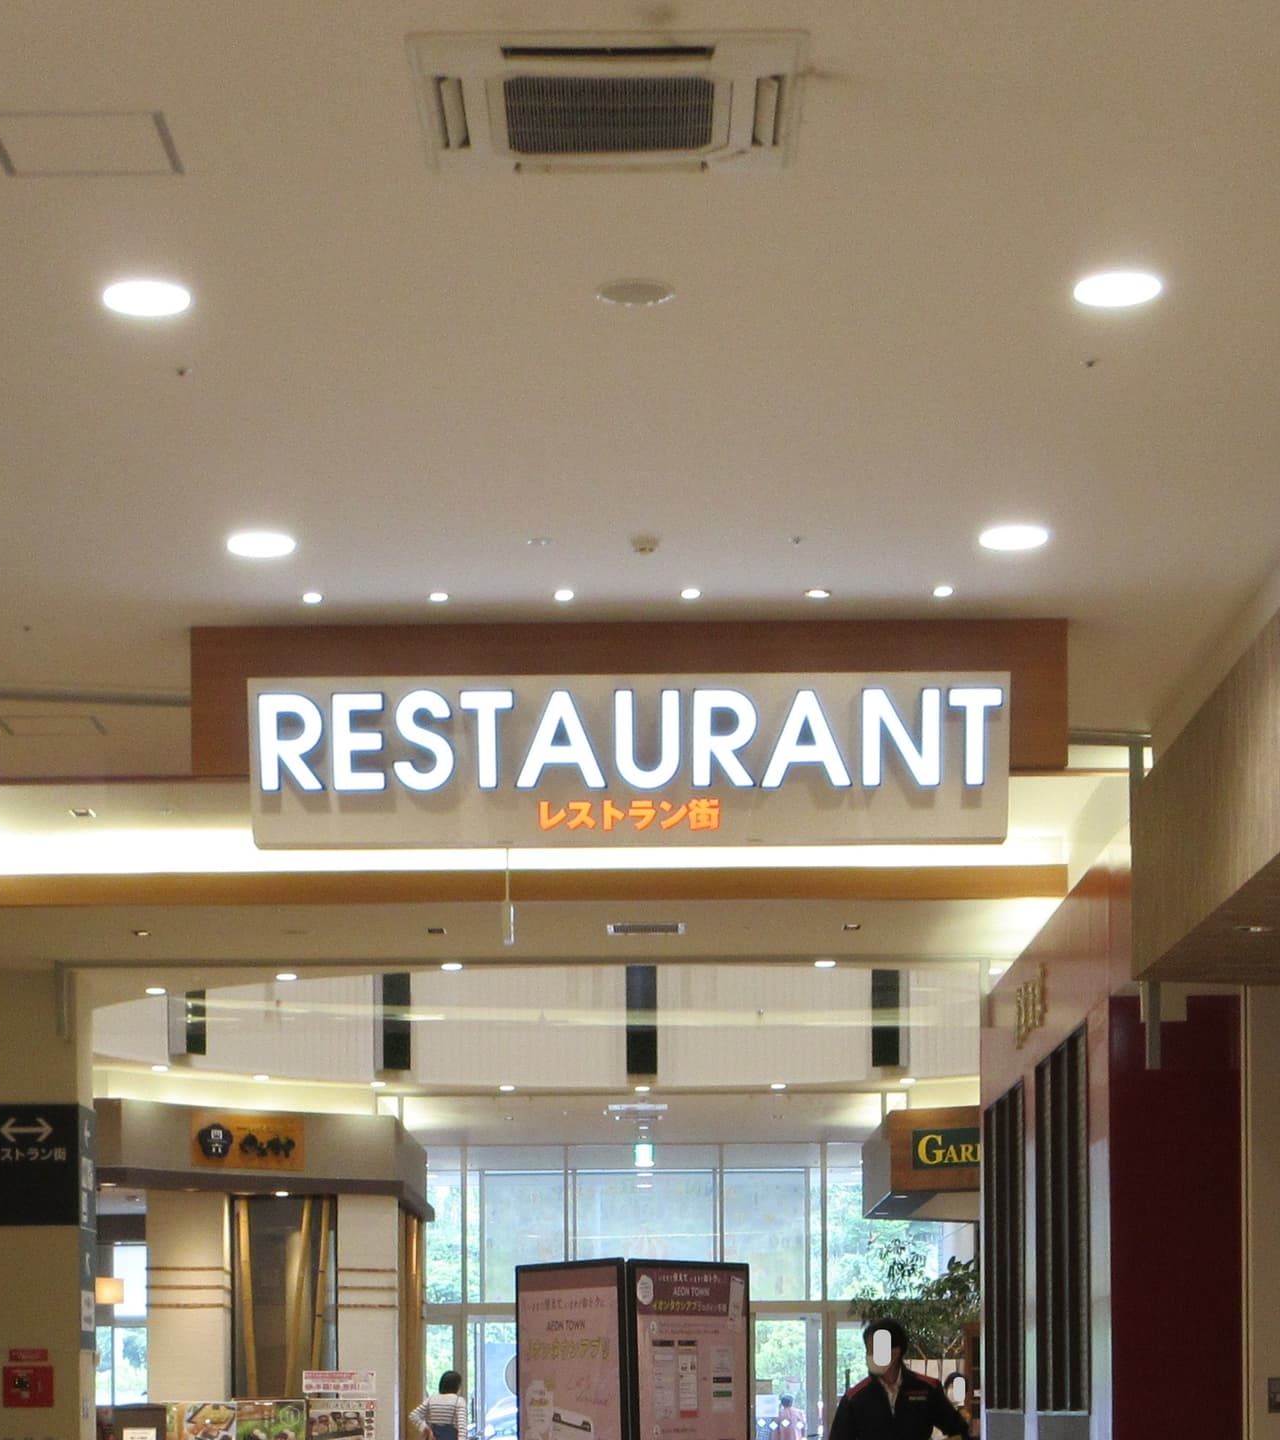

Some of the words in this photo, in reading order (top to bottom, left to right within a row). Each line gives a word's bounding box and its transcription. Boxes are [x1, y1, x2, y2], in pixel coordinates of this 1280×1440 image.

[256, 688, 1004, 793] RESTAURANT
[538, 797, 721, 831] レストラン街
